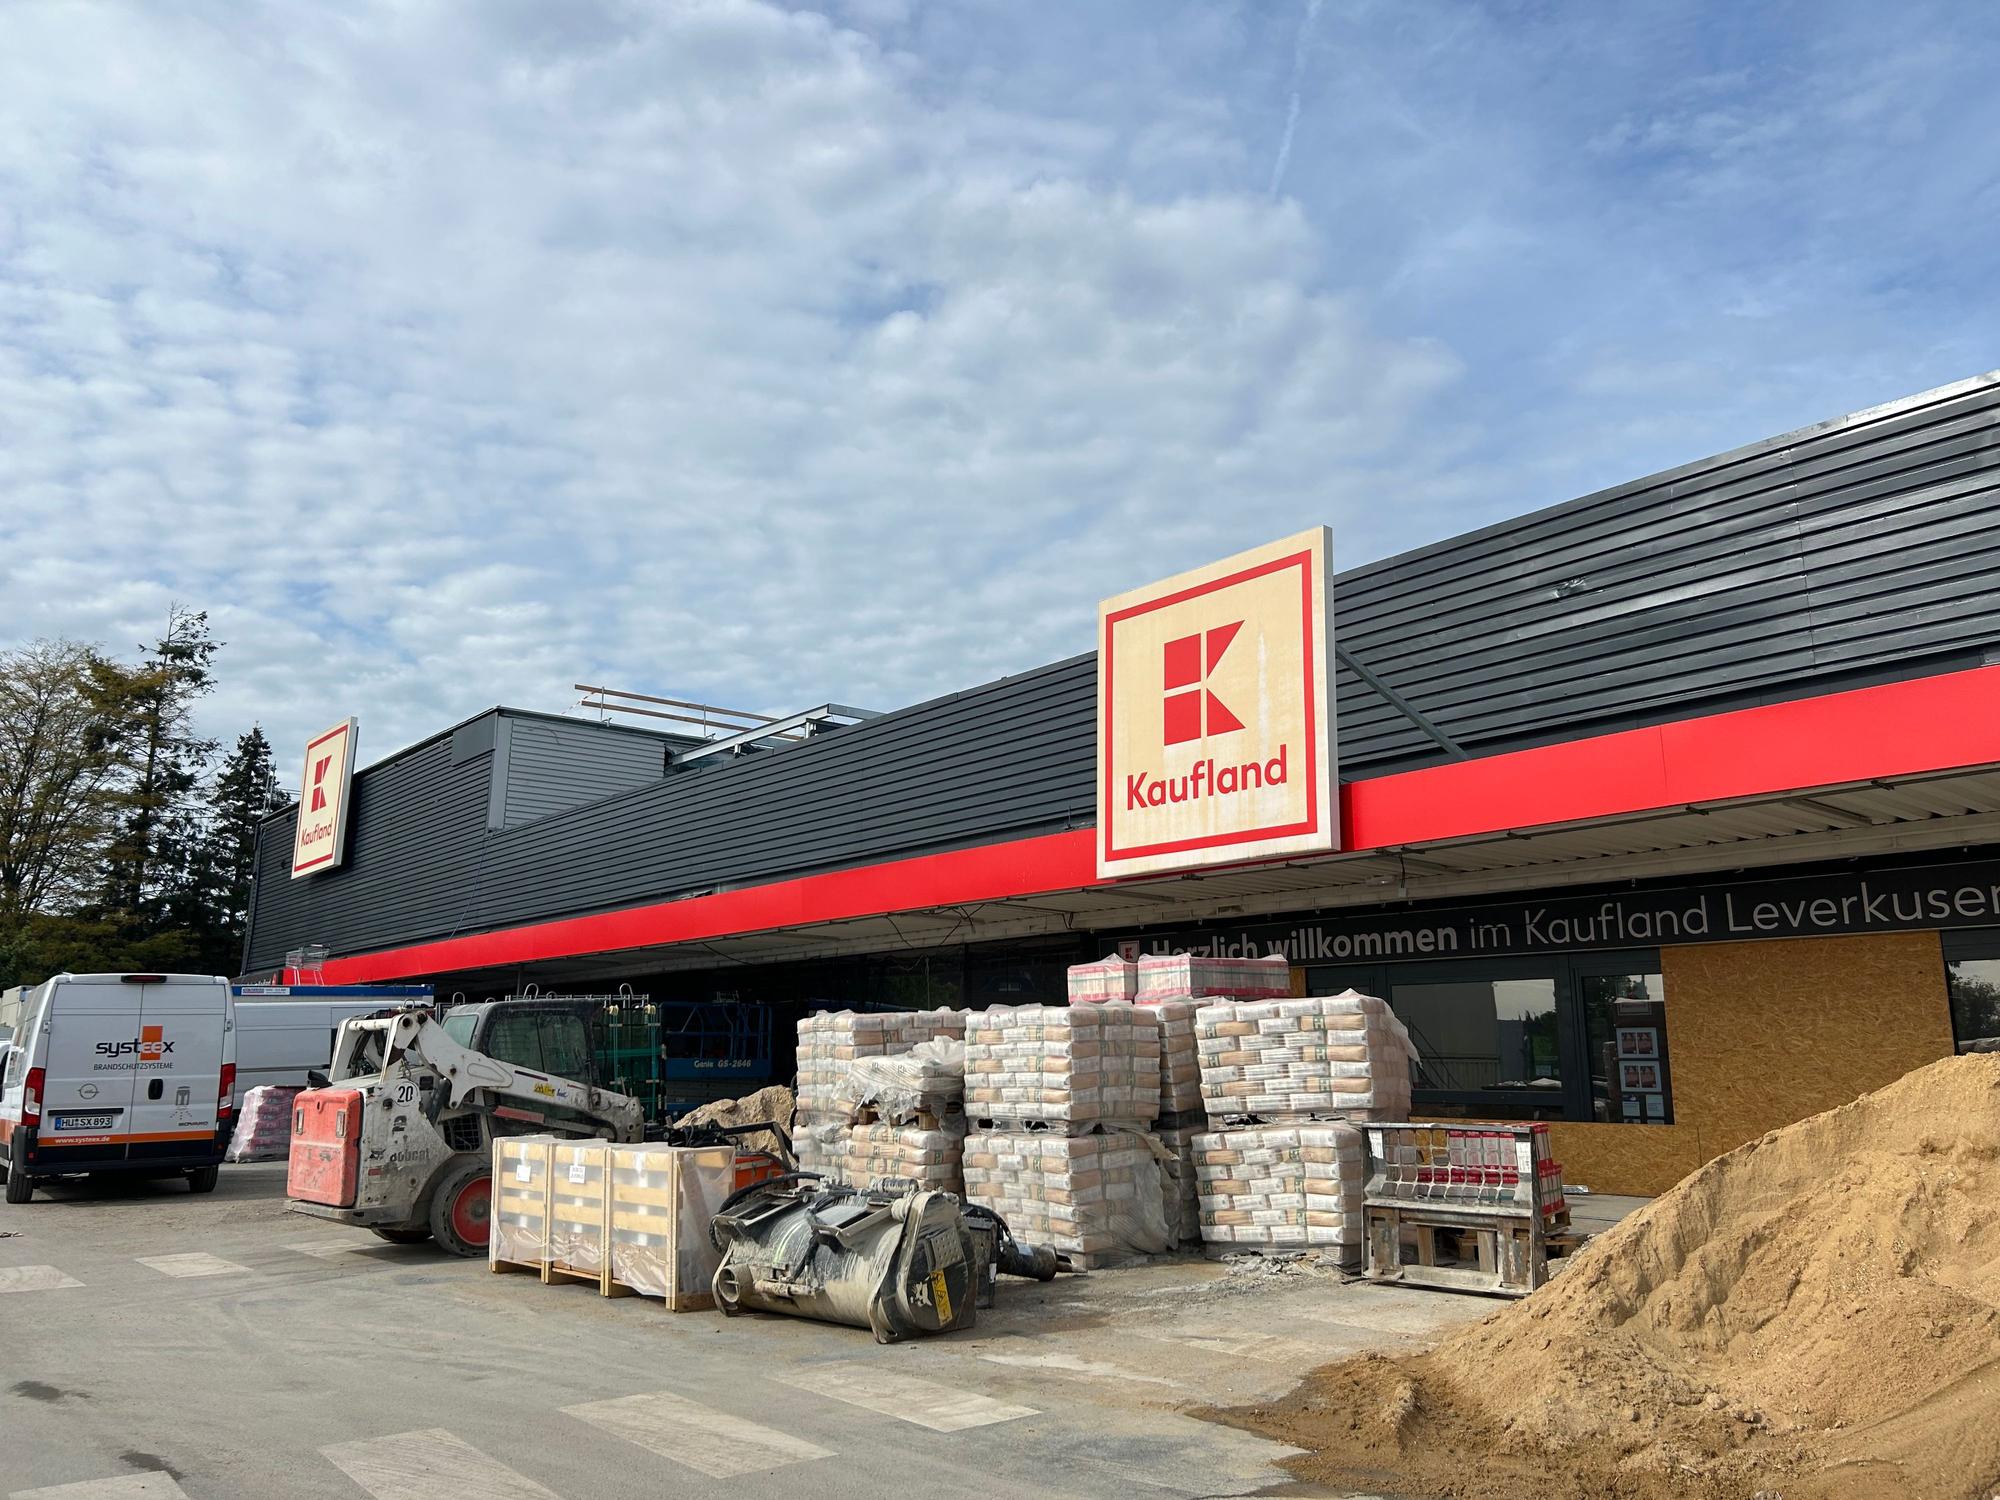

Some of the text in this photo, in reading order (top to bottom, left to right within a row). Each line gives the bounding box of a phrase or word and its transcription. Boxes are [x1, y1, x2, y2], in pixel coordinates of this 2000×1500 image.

[1127, 743, 1287, 811] Kaufland
[300, 817, 333, 847] Kaufland
[1266, 926, 1458, 960] willkommen
[1469, 918, 1512, 949] im
[1524, 895, 1709, 945] Kaufland
[95, 1038, 175, 1058] systeex
[93, 1062, 175, 1071] BRANDSCHUTZSYSTEME
[693, 1060, 714, 1068] Genie
[397, 1085, 414, 1102] 20
[80, 1118, 93, 1126] SX
[93, 1117, 111, 1126] 893
